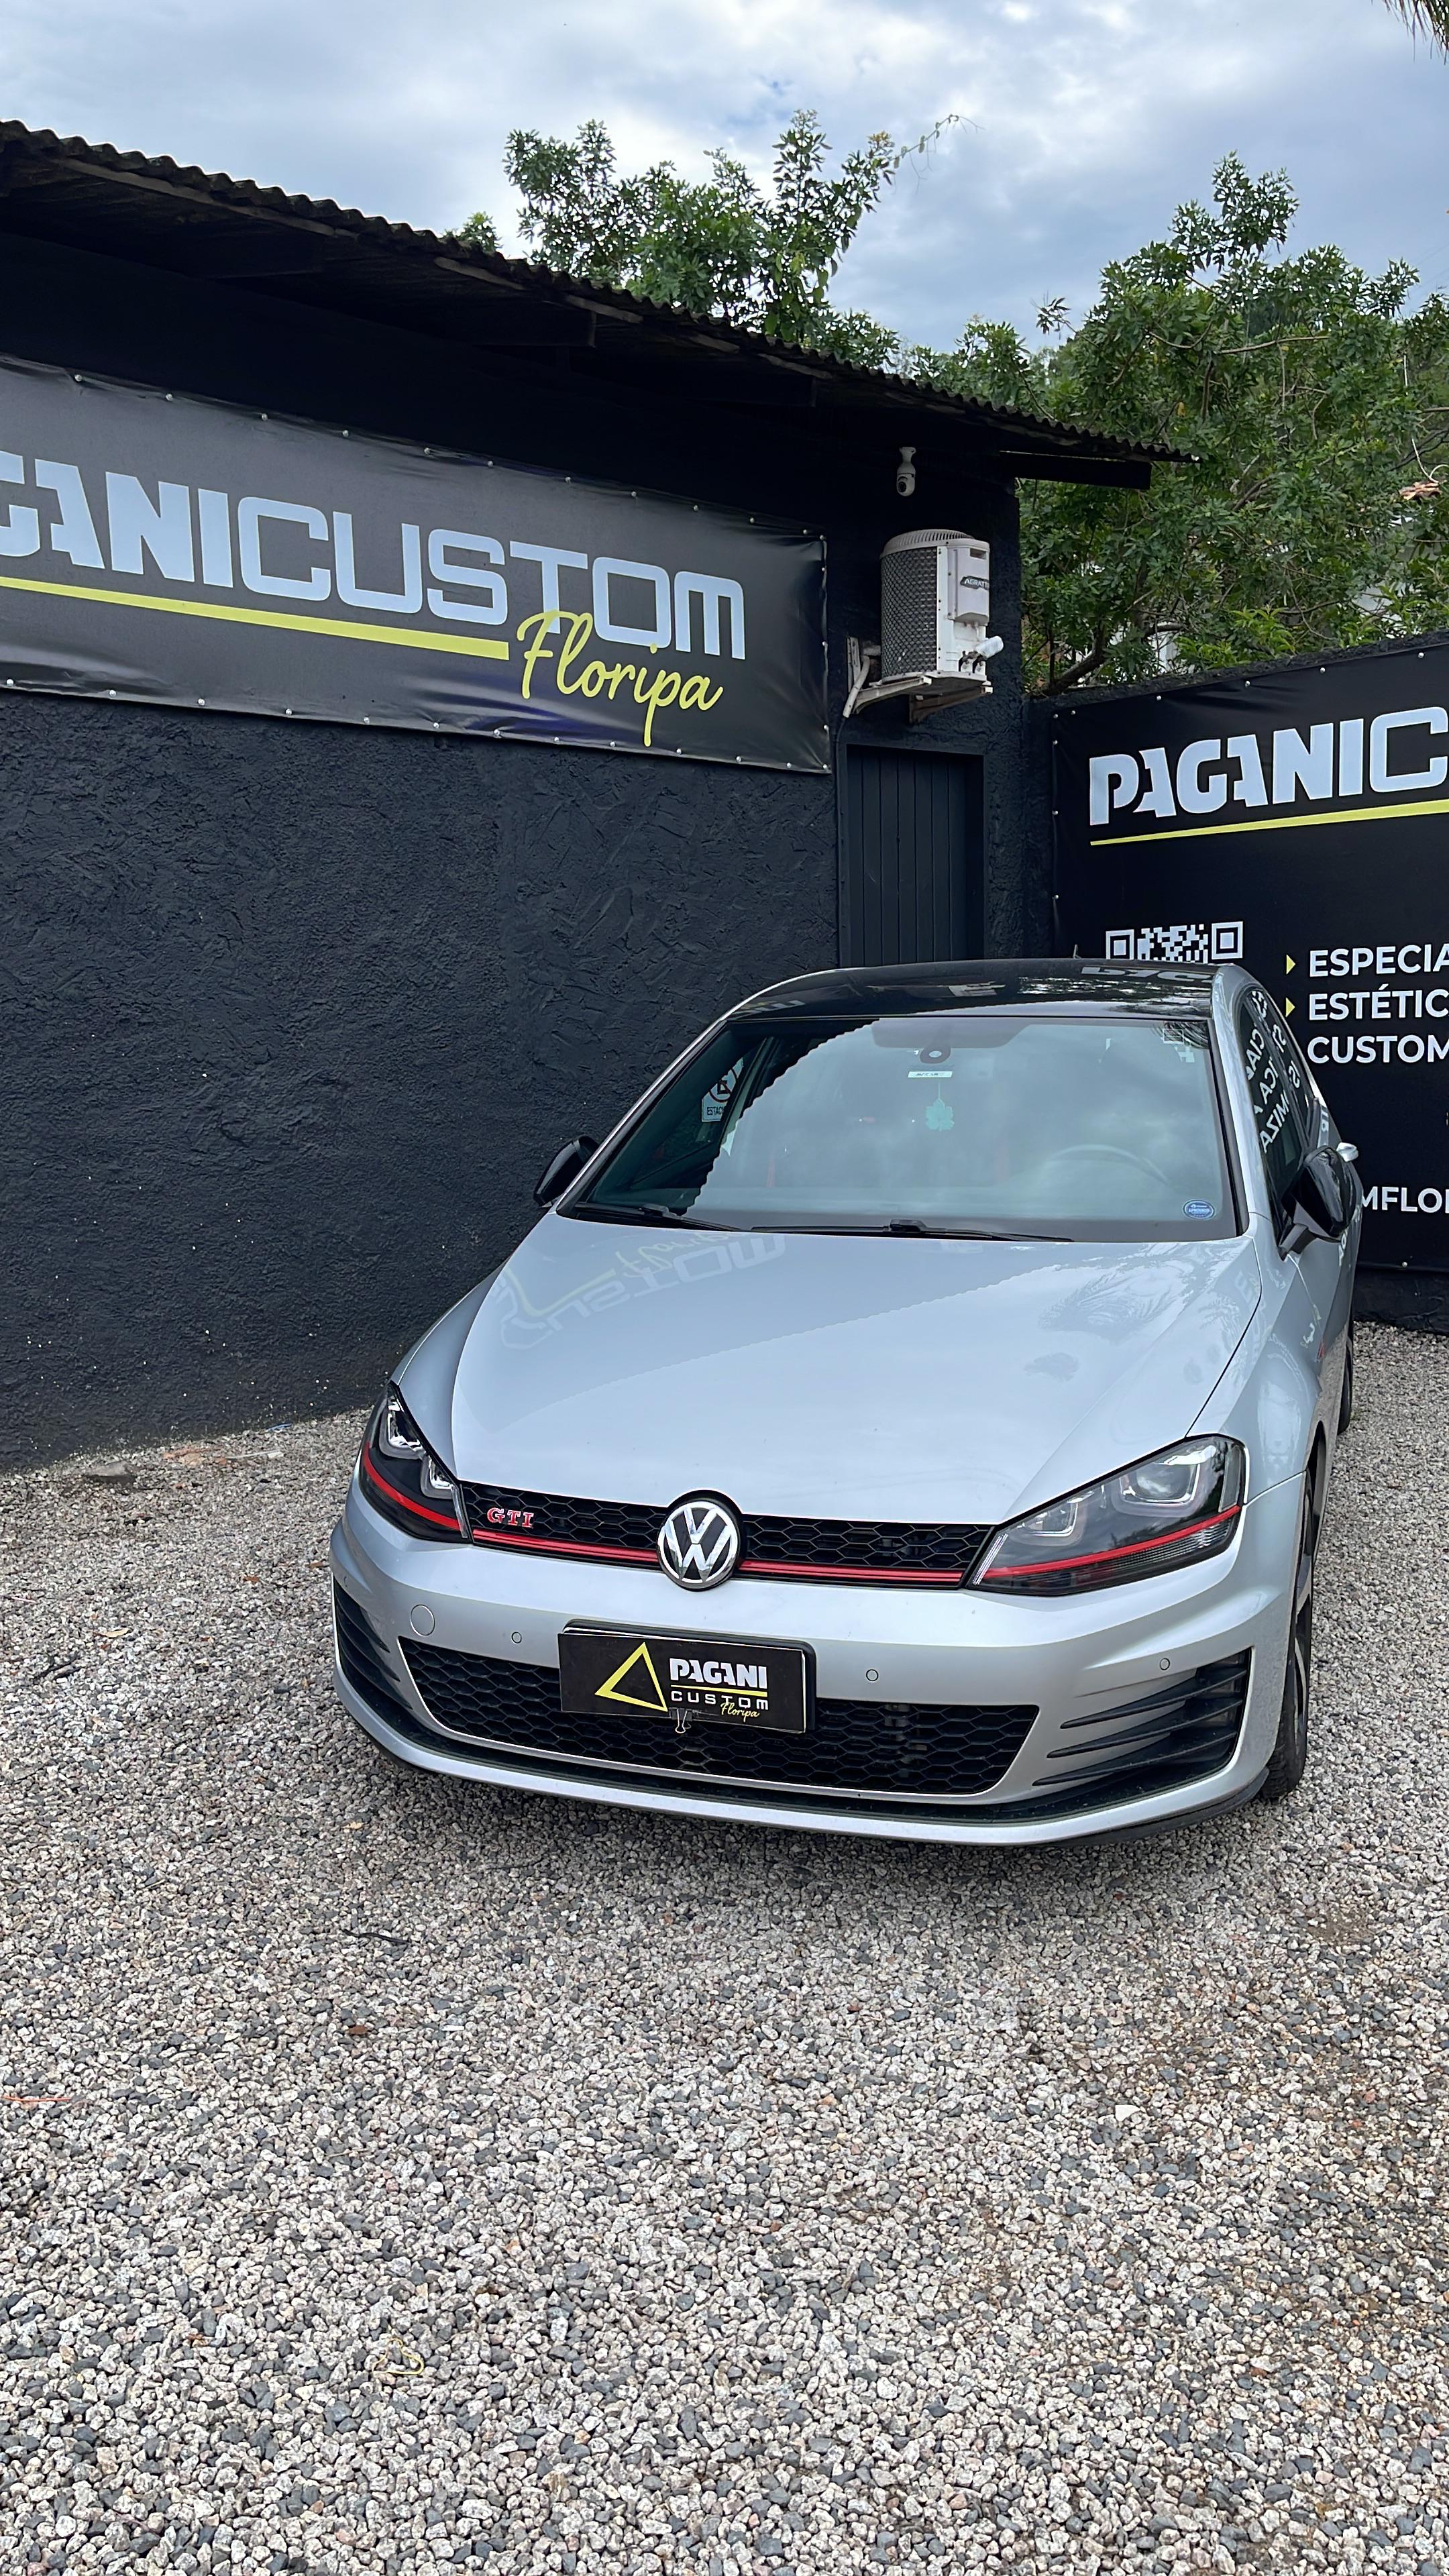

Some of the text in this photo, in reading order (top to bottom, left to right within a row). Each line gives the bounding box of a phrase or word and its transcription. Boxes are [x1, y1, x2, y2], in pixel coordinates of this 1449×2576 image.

[516, 608, 724, 747] Floripa
[1089, 706, 1448, 826] PAGANIC
[1309, 983, 1449, 1020] ESTÉTIC
[1307, 1034, 1449, 1064] CUSTOM
[486, 1507, 535, 1528] GTI
[660, 1503, 737, 1583] VW
[669, 1658, 767, 1689] PAGANI
[671, 1690, 769, 1710] CUSTOM
[720, 1702, 760, 1723] Floripa
